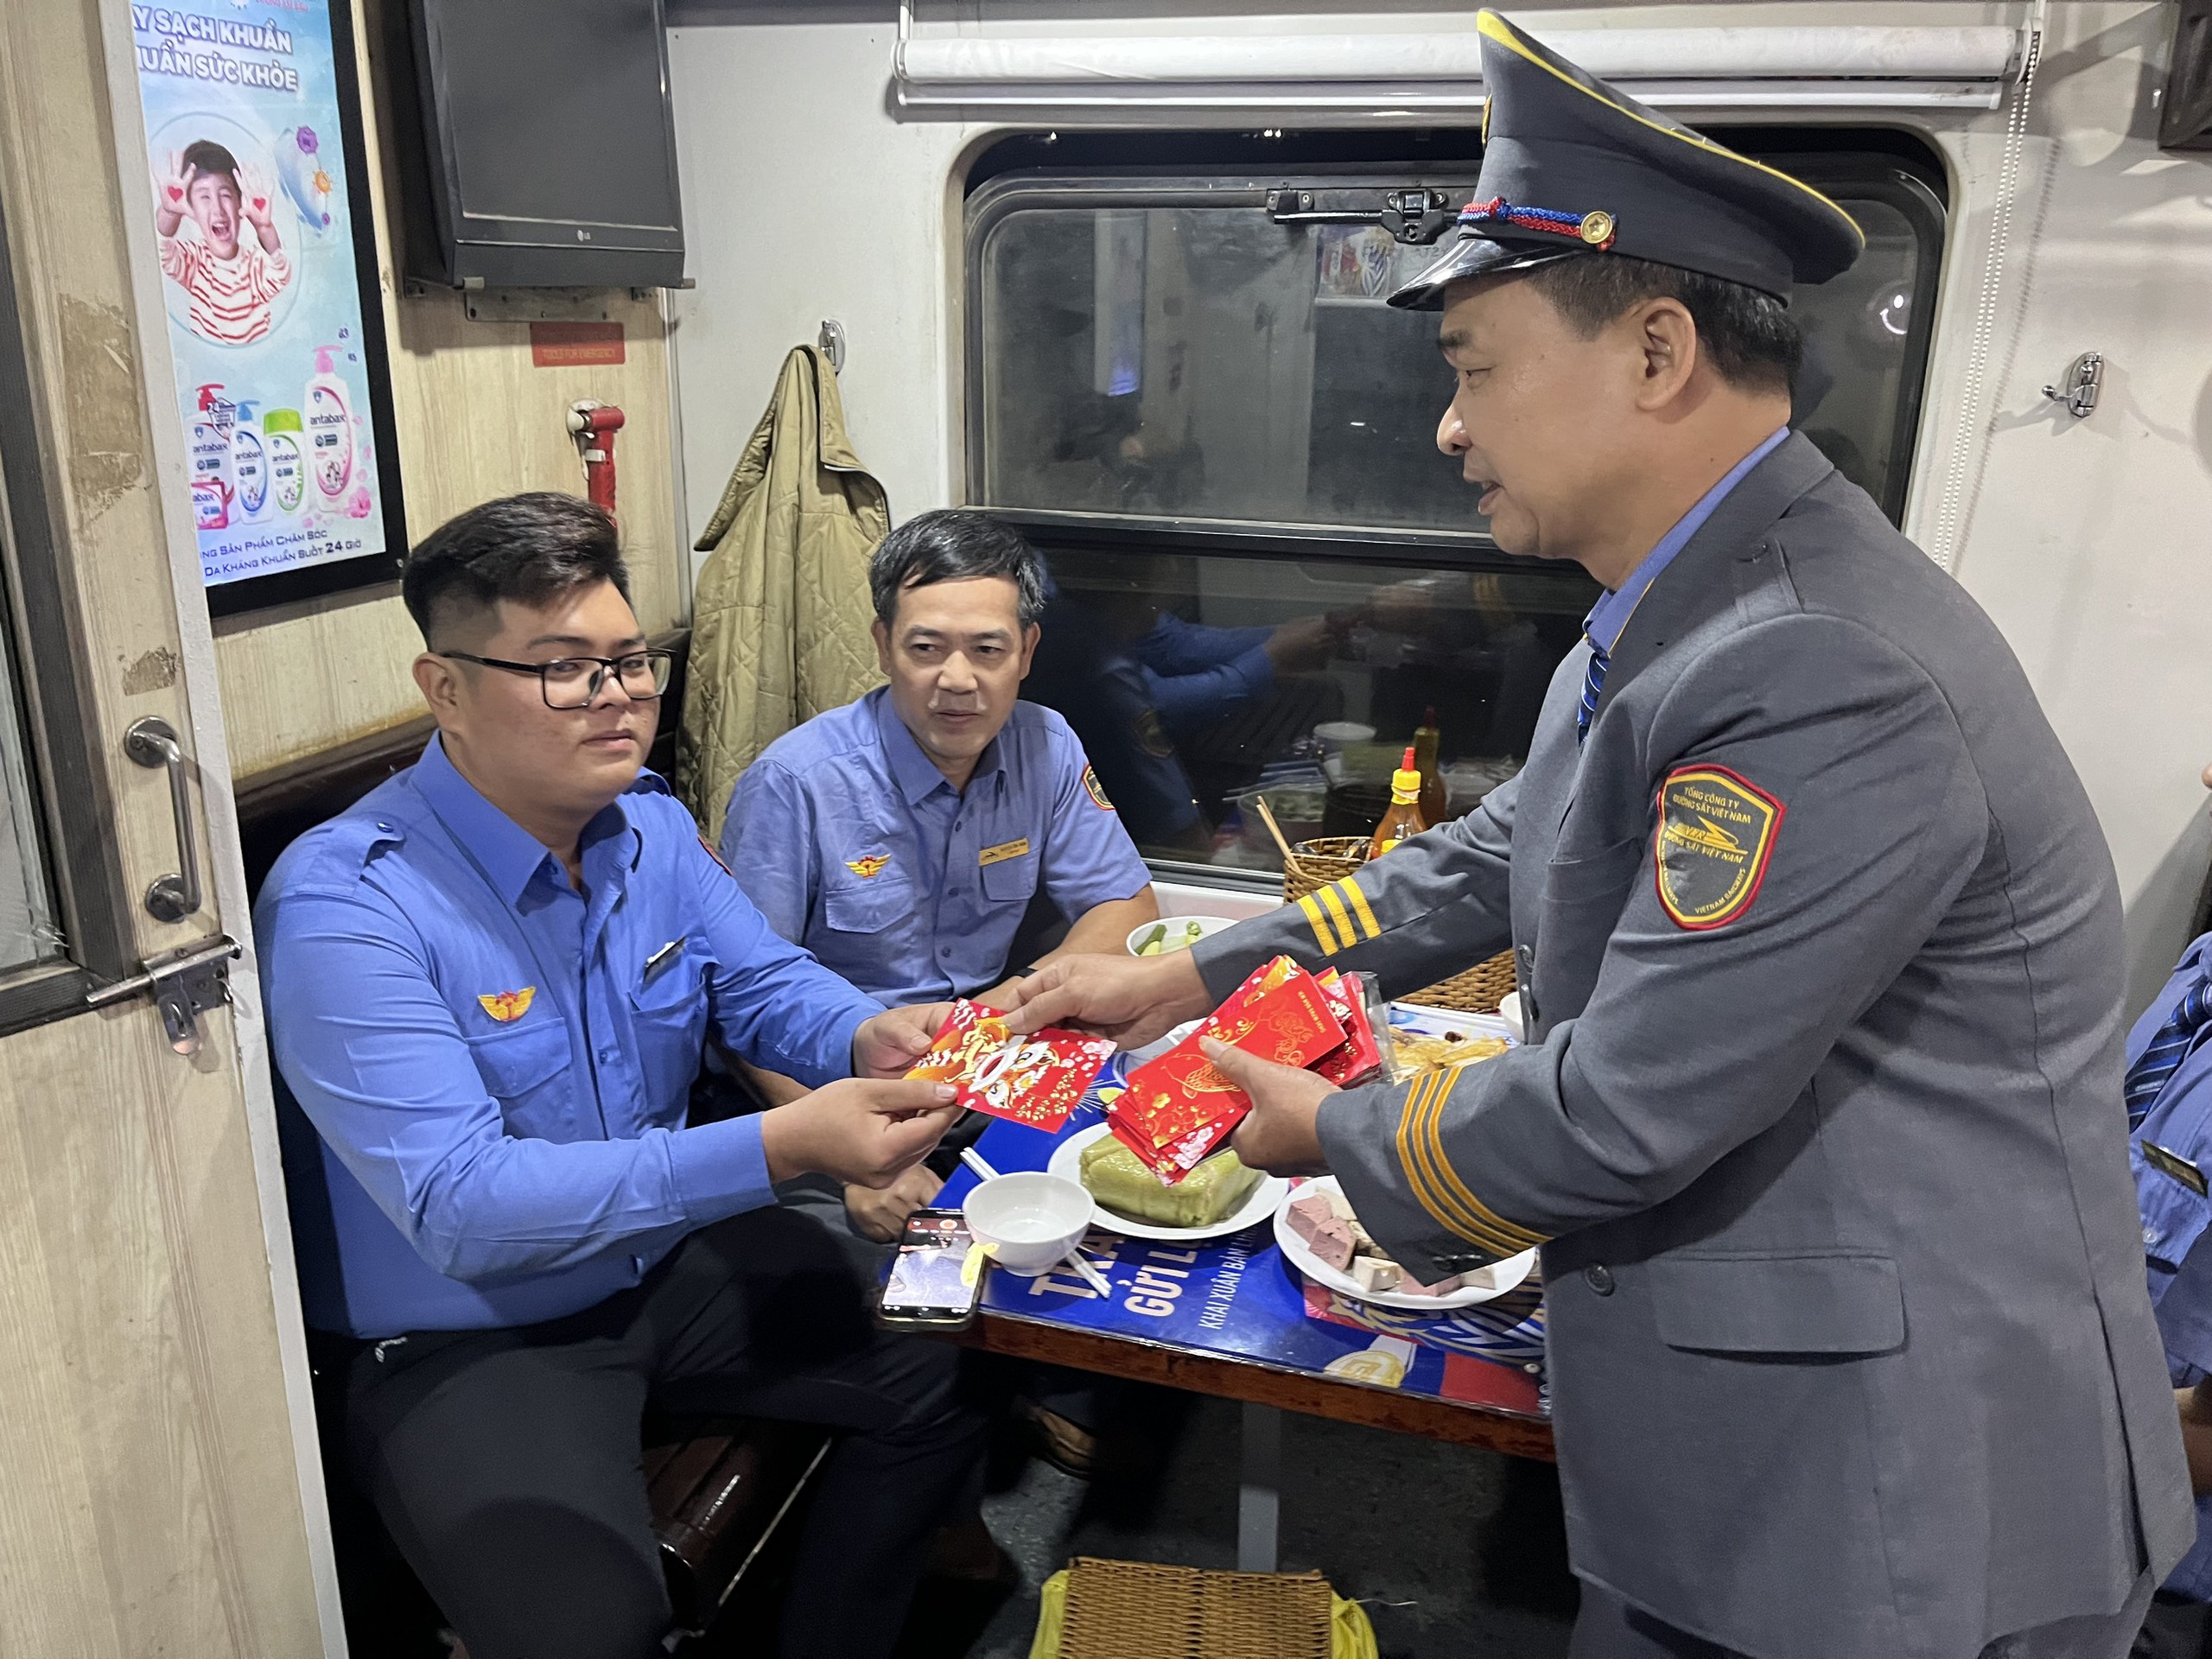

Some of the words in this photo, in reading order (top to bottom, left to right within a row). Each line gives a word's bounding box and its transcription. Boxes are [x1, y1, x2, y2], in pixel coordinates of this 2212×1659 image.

[154, 8, 217, 44] SẠCH
[219, 17, 293, 54] KHUẨN
[194, 50, 239, 83] SỨC
[239, 60, 298, 91] KHỎE
[309, 413, 346, 425] antabax
[193, 442, 227, 454] antabax
[325, 541, 343, 554] 24
[1704, 794, 1726, 808] CÔNG
[1729, 811, 1751, 824] NAM
[1721, 852, 1745, 865] NAM
[1209, 1270, 1243, 1301] XUÂN
[1198, 1300, 1231, 1330] KHAI
